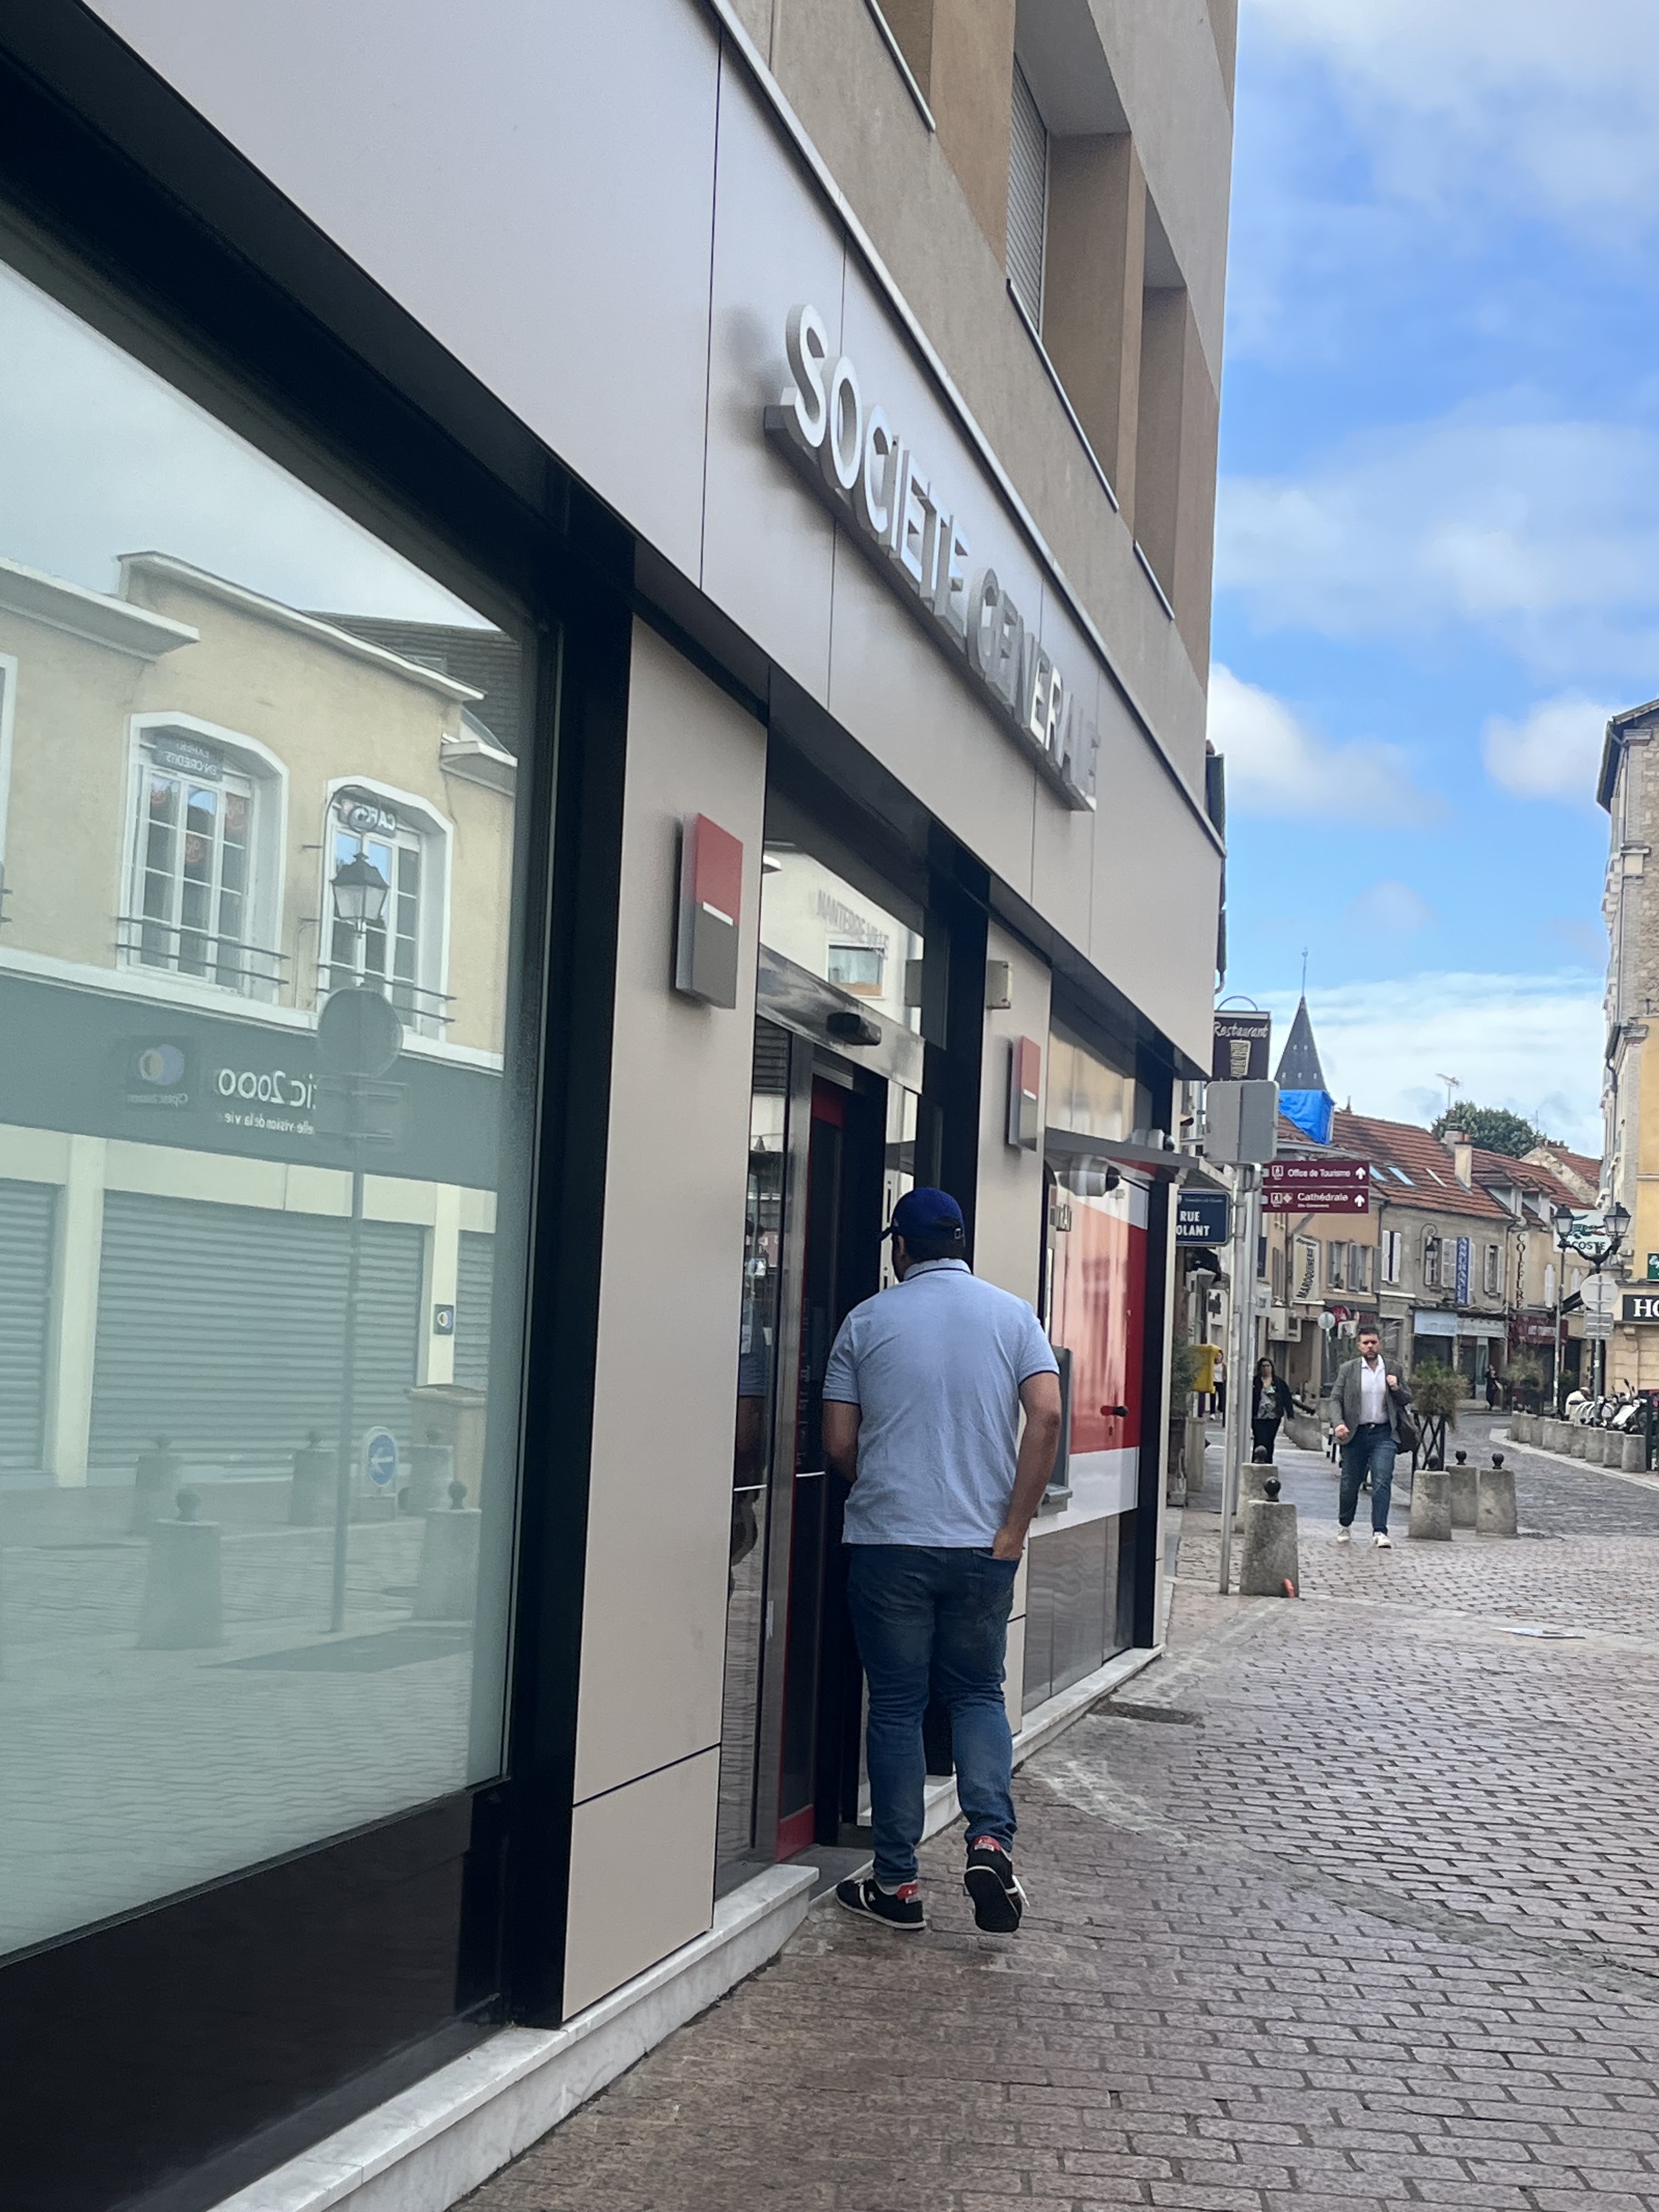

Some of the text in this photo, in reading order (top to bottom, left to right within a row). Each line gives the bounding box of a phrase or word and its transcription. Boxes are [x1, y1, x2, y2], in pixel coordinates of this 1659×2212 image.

[783, 303, 970, 651] SOCIETE
[1214, 1021, 1268, 1038] Restaurant
[1288, 1169, 1351, 1177] Office de Tourisme
[1297, 1192, 1349, 1201] Cathédrale
[1180, 1210, 1200, 1222] RUE
[1176, 1224, 1210, 1237] OLANT
[1516, 1233, 1526, 1310] COIFFURE
